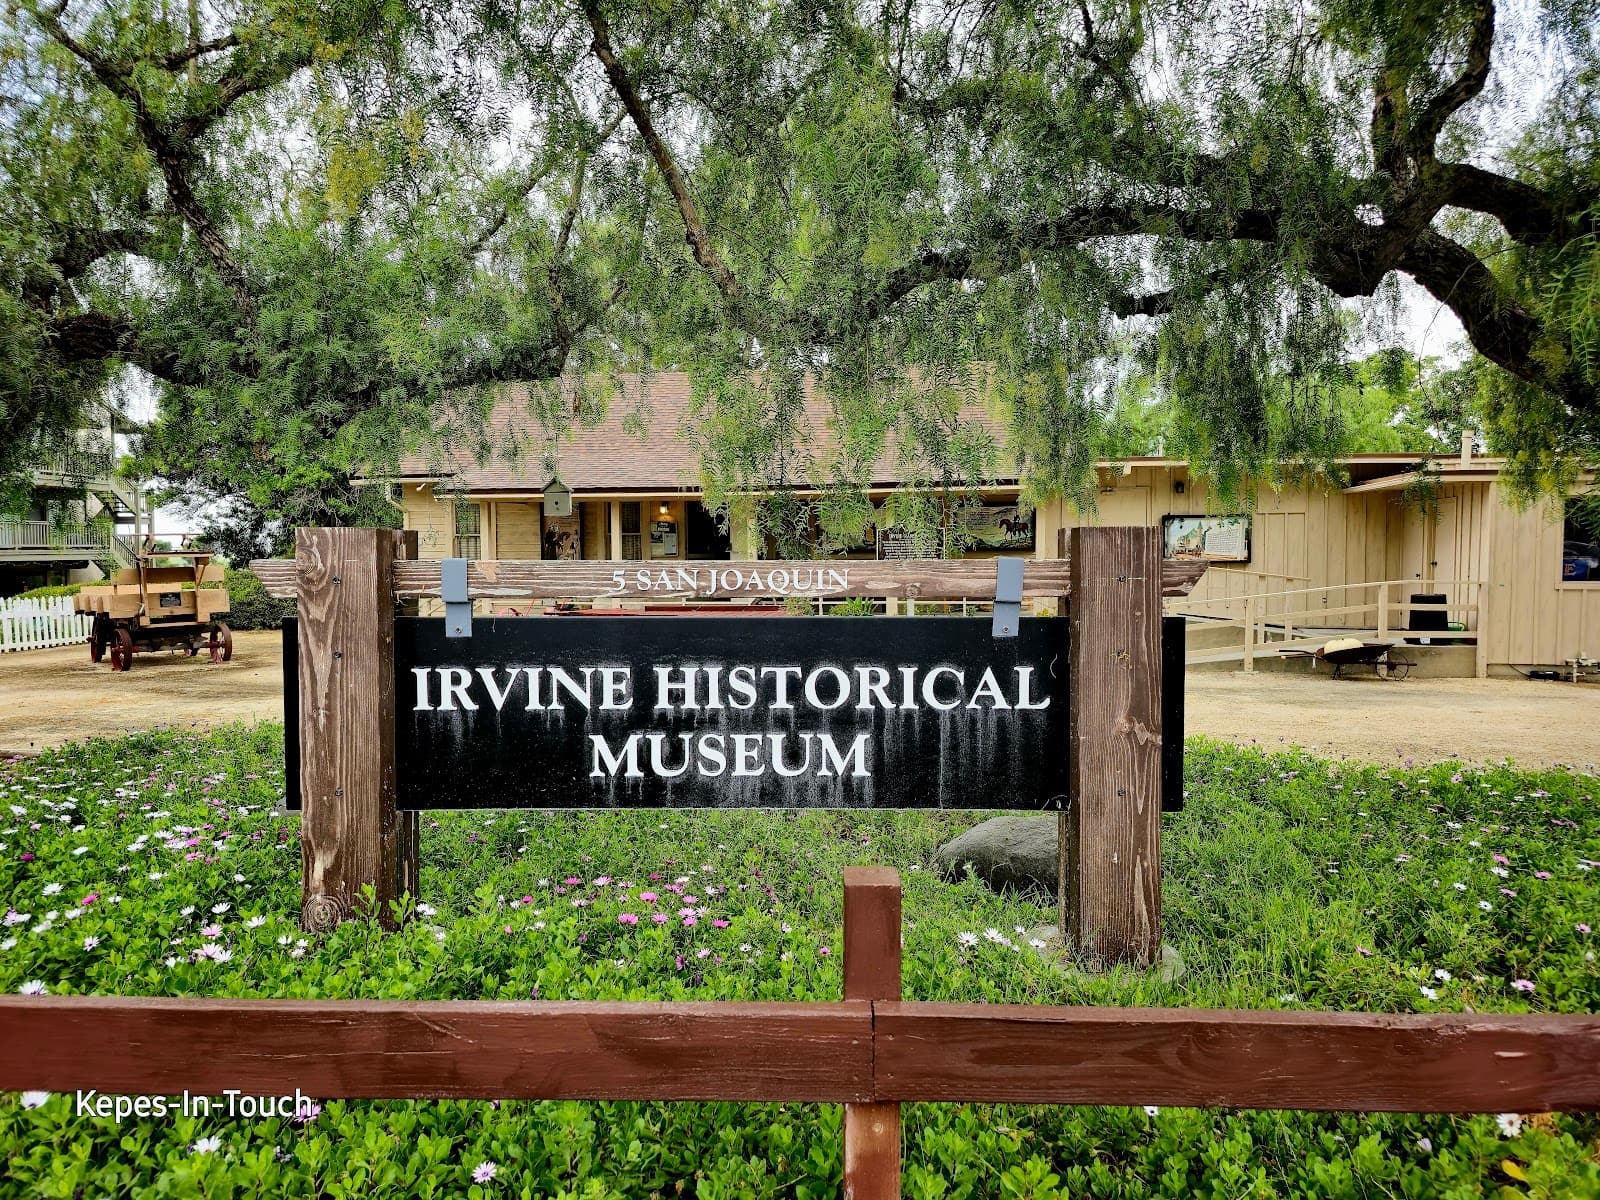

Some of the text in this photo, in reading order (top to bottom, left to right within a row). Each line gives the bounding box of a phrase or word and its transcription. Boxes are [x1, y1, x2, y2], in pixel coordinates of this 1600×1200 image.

[612, 568, 850, 595] 5 SAN JOAQUIN
[410, 665, 1051, 711] IRVINE HISTORICAL
[588, 732, 872, 777] MUSEUM
